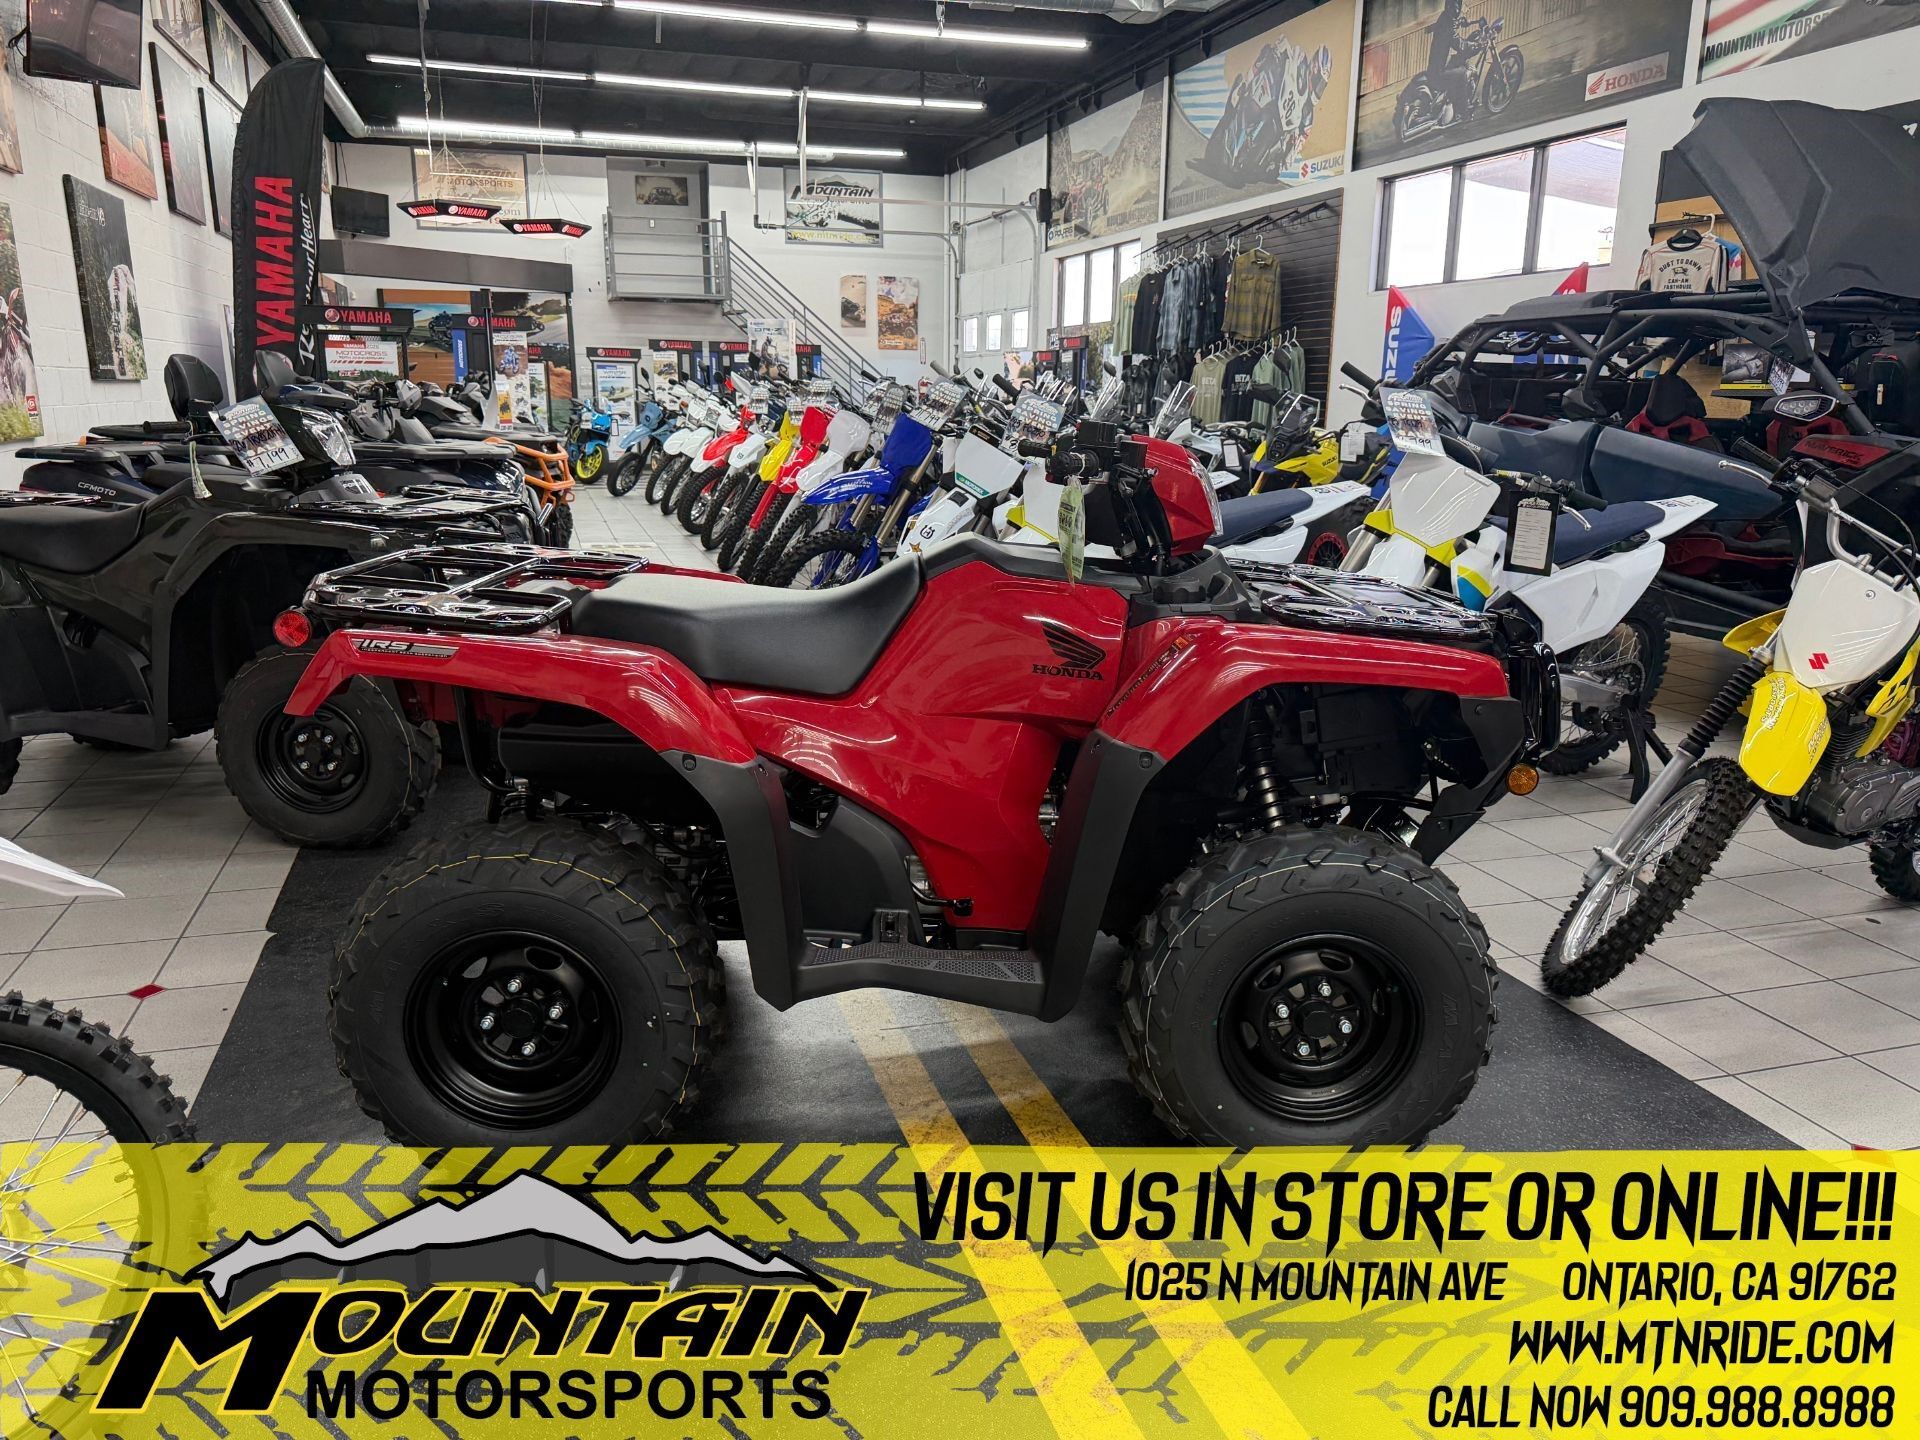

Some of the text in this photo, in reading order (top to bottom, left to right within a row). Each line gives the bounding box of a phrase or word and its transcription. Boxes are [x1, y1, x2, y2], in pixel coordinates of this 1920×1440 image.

[1705, 30, 1766, 63] MOUNTAIN
[1604, 64, 1665, 92] HONDA
[1310, 155, 1344, 174] SUZUKI
[457, 206, 488, 217] YAMAHA
[521, 223, 553, 232] YAMAHA
[255, 176, 296, 346] YAMAHA
[340, 310, 392, 324] YAMAHA
[479, 317, 516, 328] YMAHA
[604, 349, 632, 358] YAMAHA
[667, 341, 693, 350] YAMAHA
[1022, 403, 1057, 422] SPRING
[1385, 405, 1432, 415] SAVINGS
[1387, 400, 1427, 409] SPRING
[223, 410, 266, 429] SPRING
[1016, 407, 1058, 429] SAVINGS
[1019, 415, 1050, 432] EVENT
[1393, 412, 1427, 421] EVENT
[223, 414, 274, 436] SAVINGS
[234, 421, 271, 439] EVENT
[78, 481, 117, 496] CFMOTO
[361, 639, 410, 651] IRS
[1032, 663, 1104, 681] HONDA
